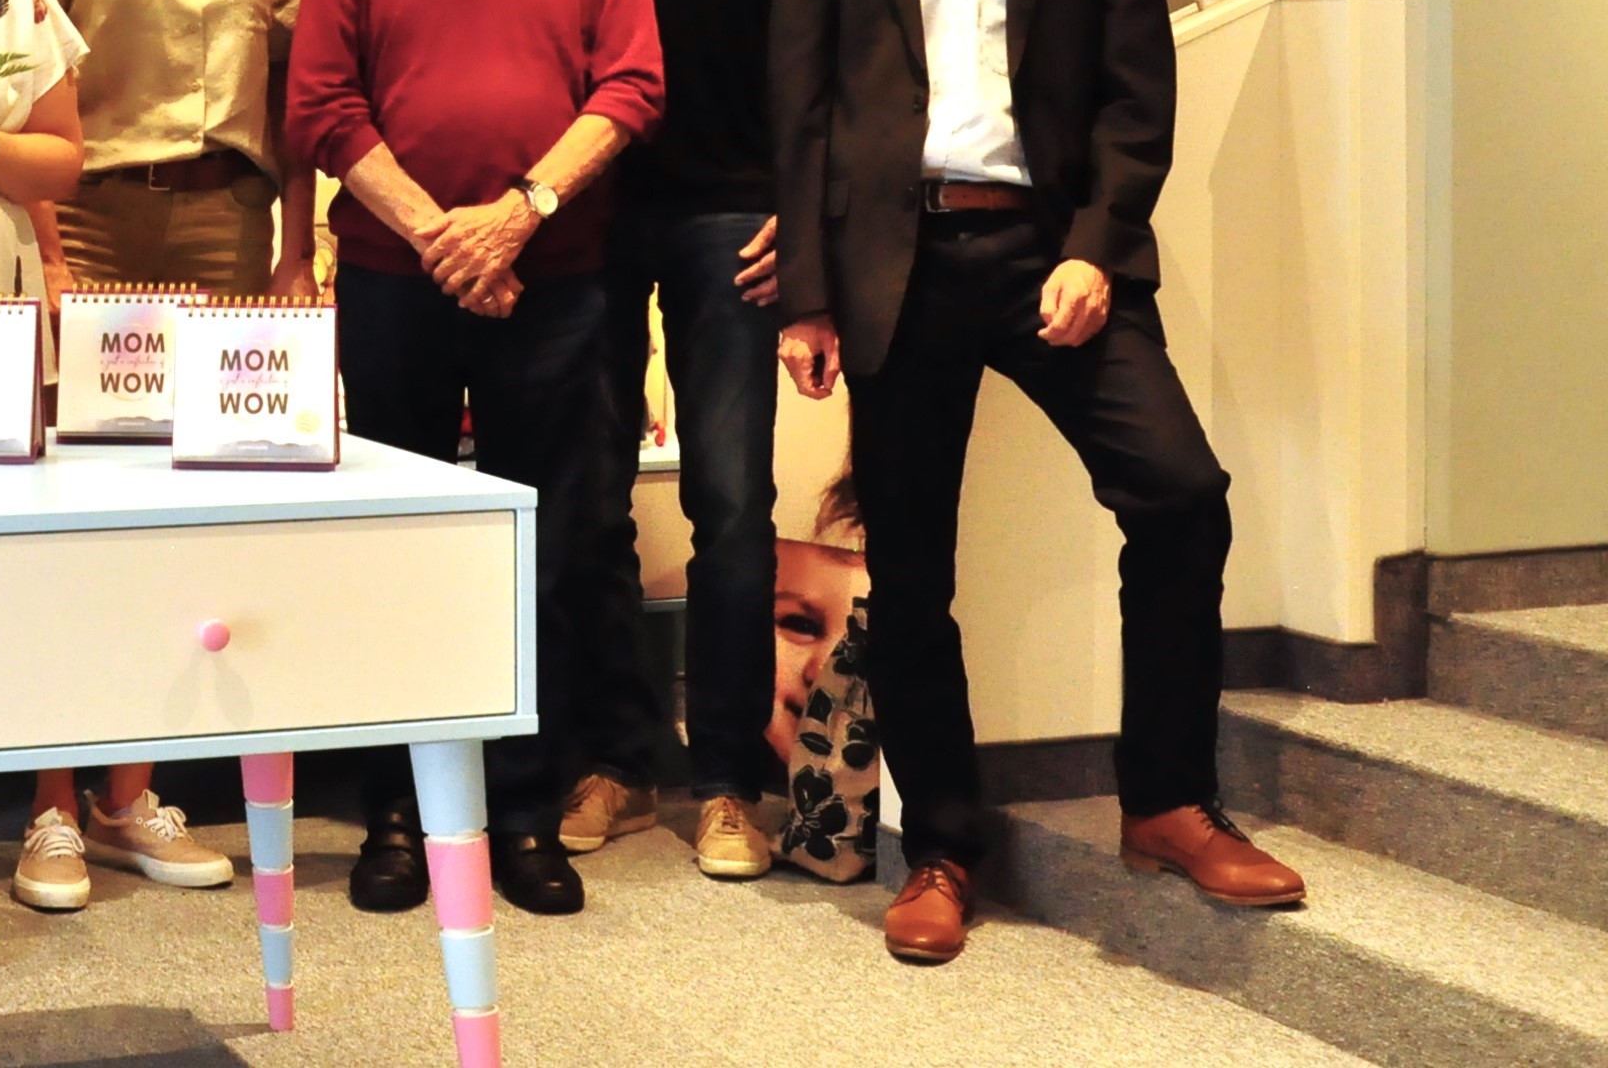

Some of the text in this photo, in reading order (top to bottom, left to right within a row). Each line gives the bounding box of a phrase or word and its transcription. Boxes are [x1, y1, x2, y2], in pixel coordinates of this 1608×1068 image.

[100, 332, 165, 353] MOM
[220, 349, 289, 372] MOM
[100, 373, 165, 394] WOW
[219, 393, 289, 415] WOW
